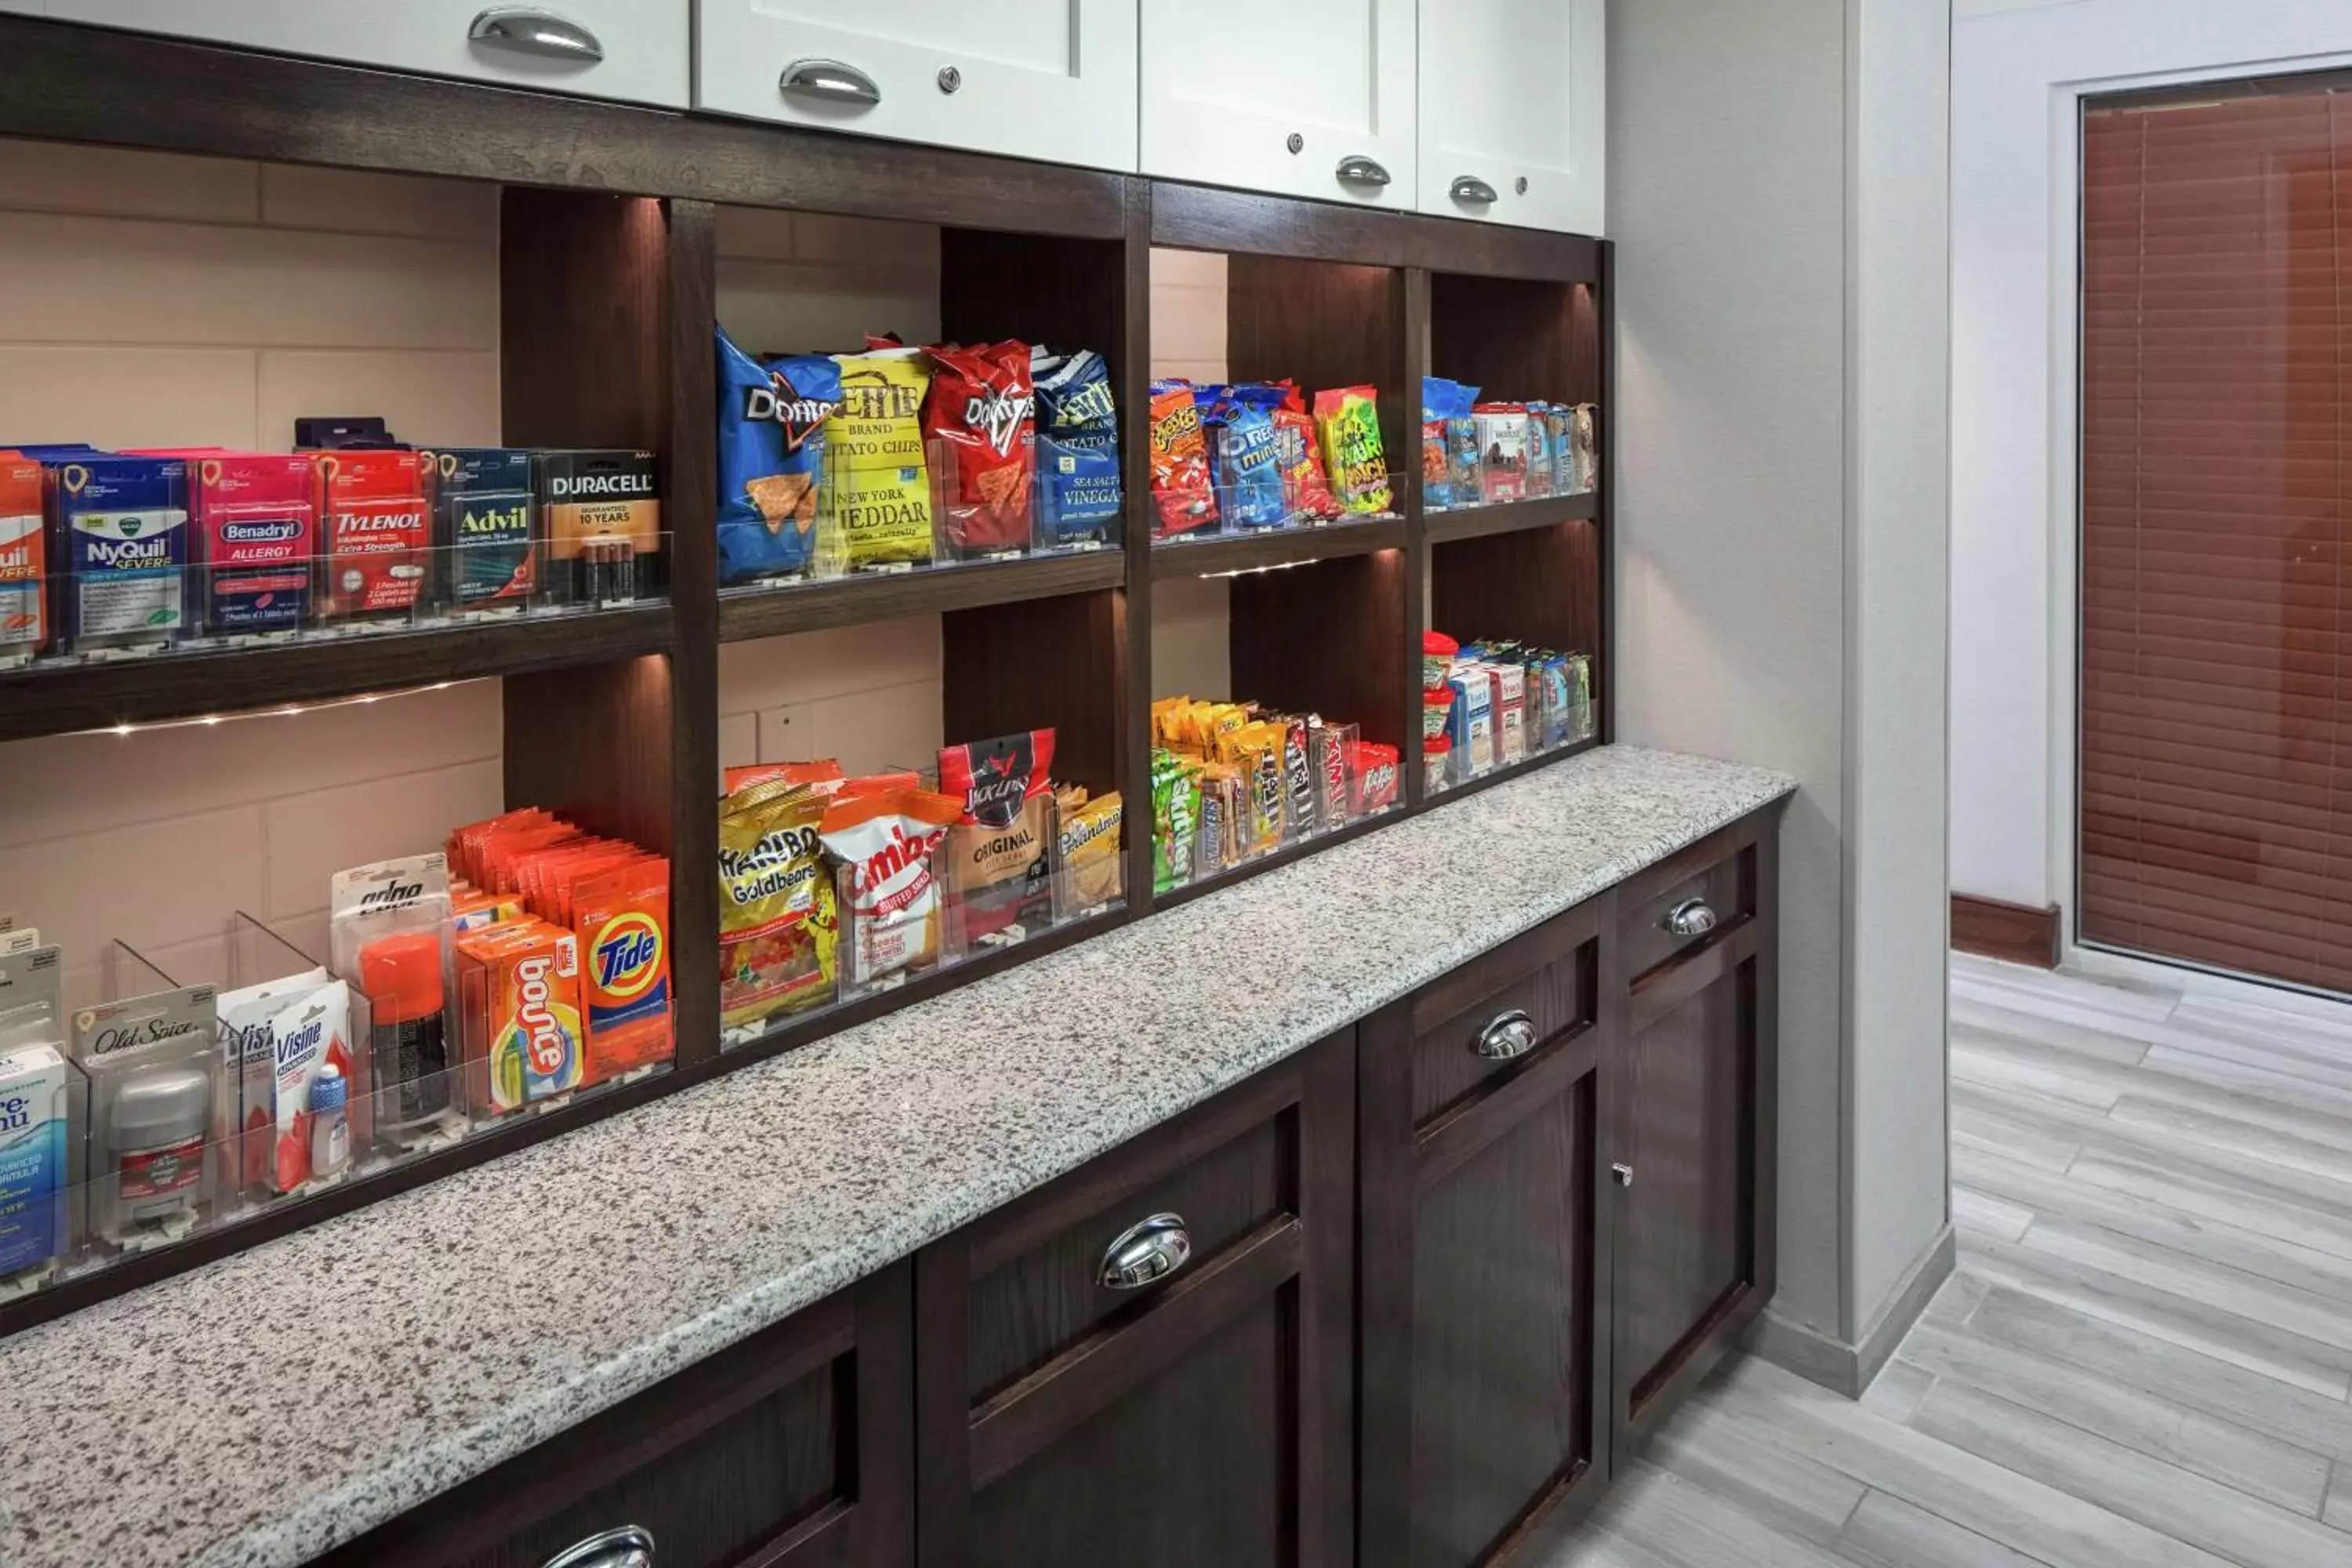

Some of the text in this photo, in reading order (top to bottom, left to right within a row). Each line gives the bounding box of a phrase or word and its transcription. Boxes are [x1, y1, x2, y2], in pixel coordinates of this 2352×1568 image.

[841, 384, 920, 419] ETTLE
[848, 424, 893, 436] BRAND
[883, 437, 921, 454] CHIPS
[554, 474, 652, 495] DURACELL
[837, 486, 906, 508] NEW YORK
[1065, 491, 1120, 506] VINEGA
[227, 521, 295, 539] Benadryl
[461, 506, 527, 532] Advil
[580, 512, 630, 524] 10 YEARS
[88, 538, 166, 566] NyQuil
[115, 556, 173, 570] SEVERE
[232, 546, 294, 559] ALLERGY
[974, 829, 1034, 863] ORIGINAL
[733, 865, 816, 904] Goldbears
[598, 928, 656, 988] Tide
[517, 956, 564, 1069] bounce
[95, 1018, 196, 1054] Old Spice
[277, 1022, 322, 1064] Visine
